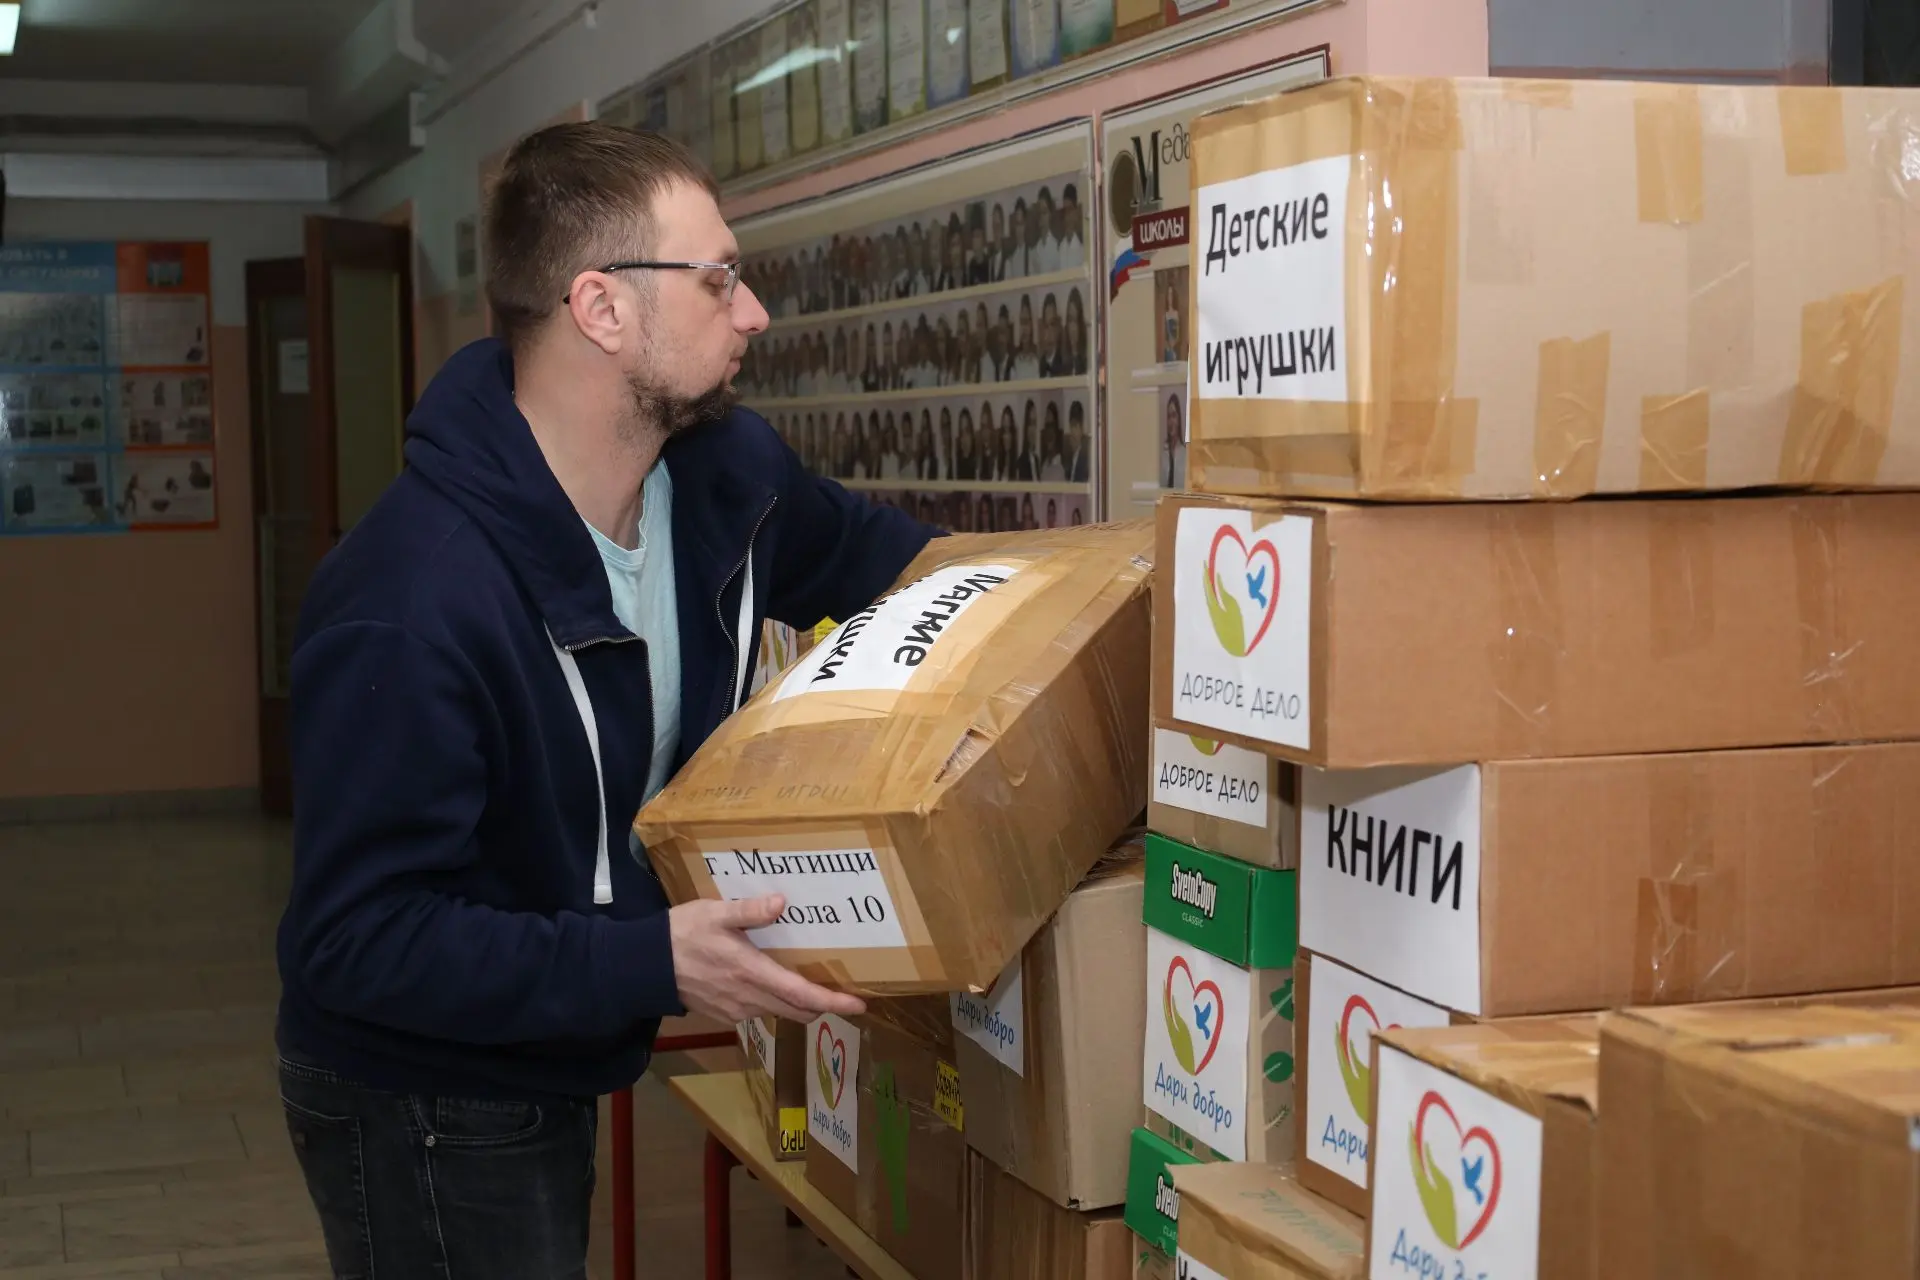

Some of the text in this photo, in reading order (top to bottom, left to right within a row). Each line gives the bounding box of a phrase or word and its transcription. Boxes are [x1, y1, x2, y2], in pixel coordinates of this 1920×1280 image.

[1206, 192, 1329, 276] Детские
[1206, 326, 1335, 396] игрушки
[893, 573, 1009, 666] Мягкие
[1180, 672, 1301, 719] ДОБРОЕ ДЕЛО
[1159, 762, 1259, 804] ДОБРОЕ ДЕЛО
[704, 848, 880, 877] г. Мытищи
[1327, 804, 1463, 911] КНИГИ
[847, 895, 885, 923] 10
[1171, 862, 1217, 918] SvetoCopy
[1181, 912, 1205, 928] CLASSIC
[957, 992, 1015, 1049] Дари добро
[1155, 1062, 1233, 1132] Дари добро
[813, 1103, 852, 1152] Дари добро
[1322, 1114, 1368, 1164] Дари
[1388, 1227, 1445, 1280] Дари
